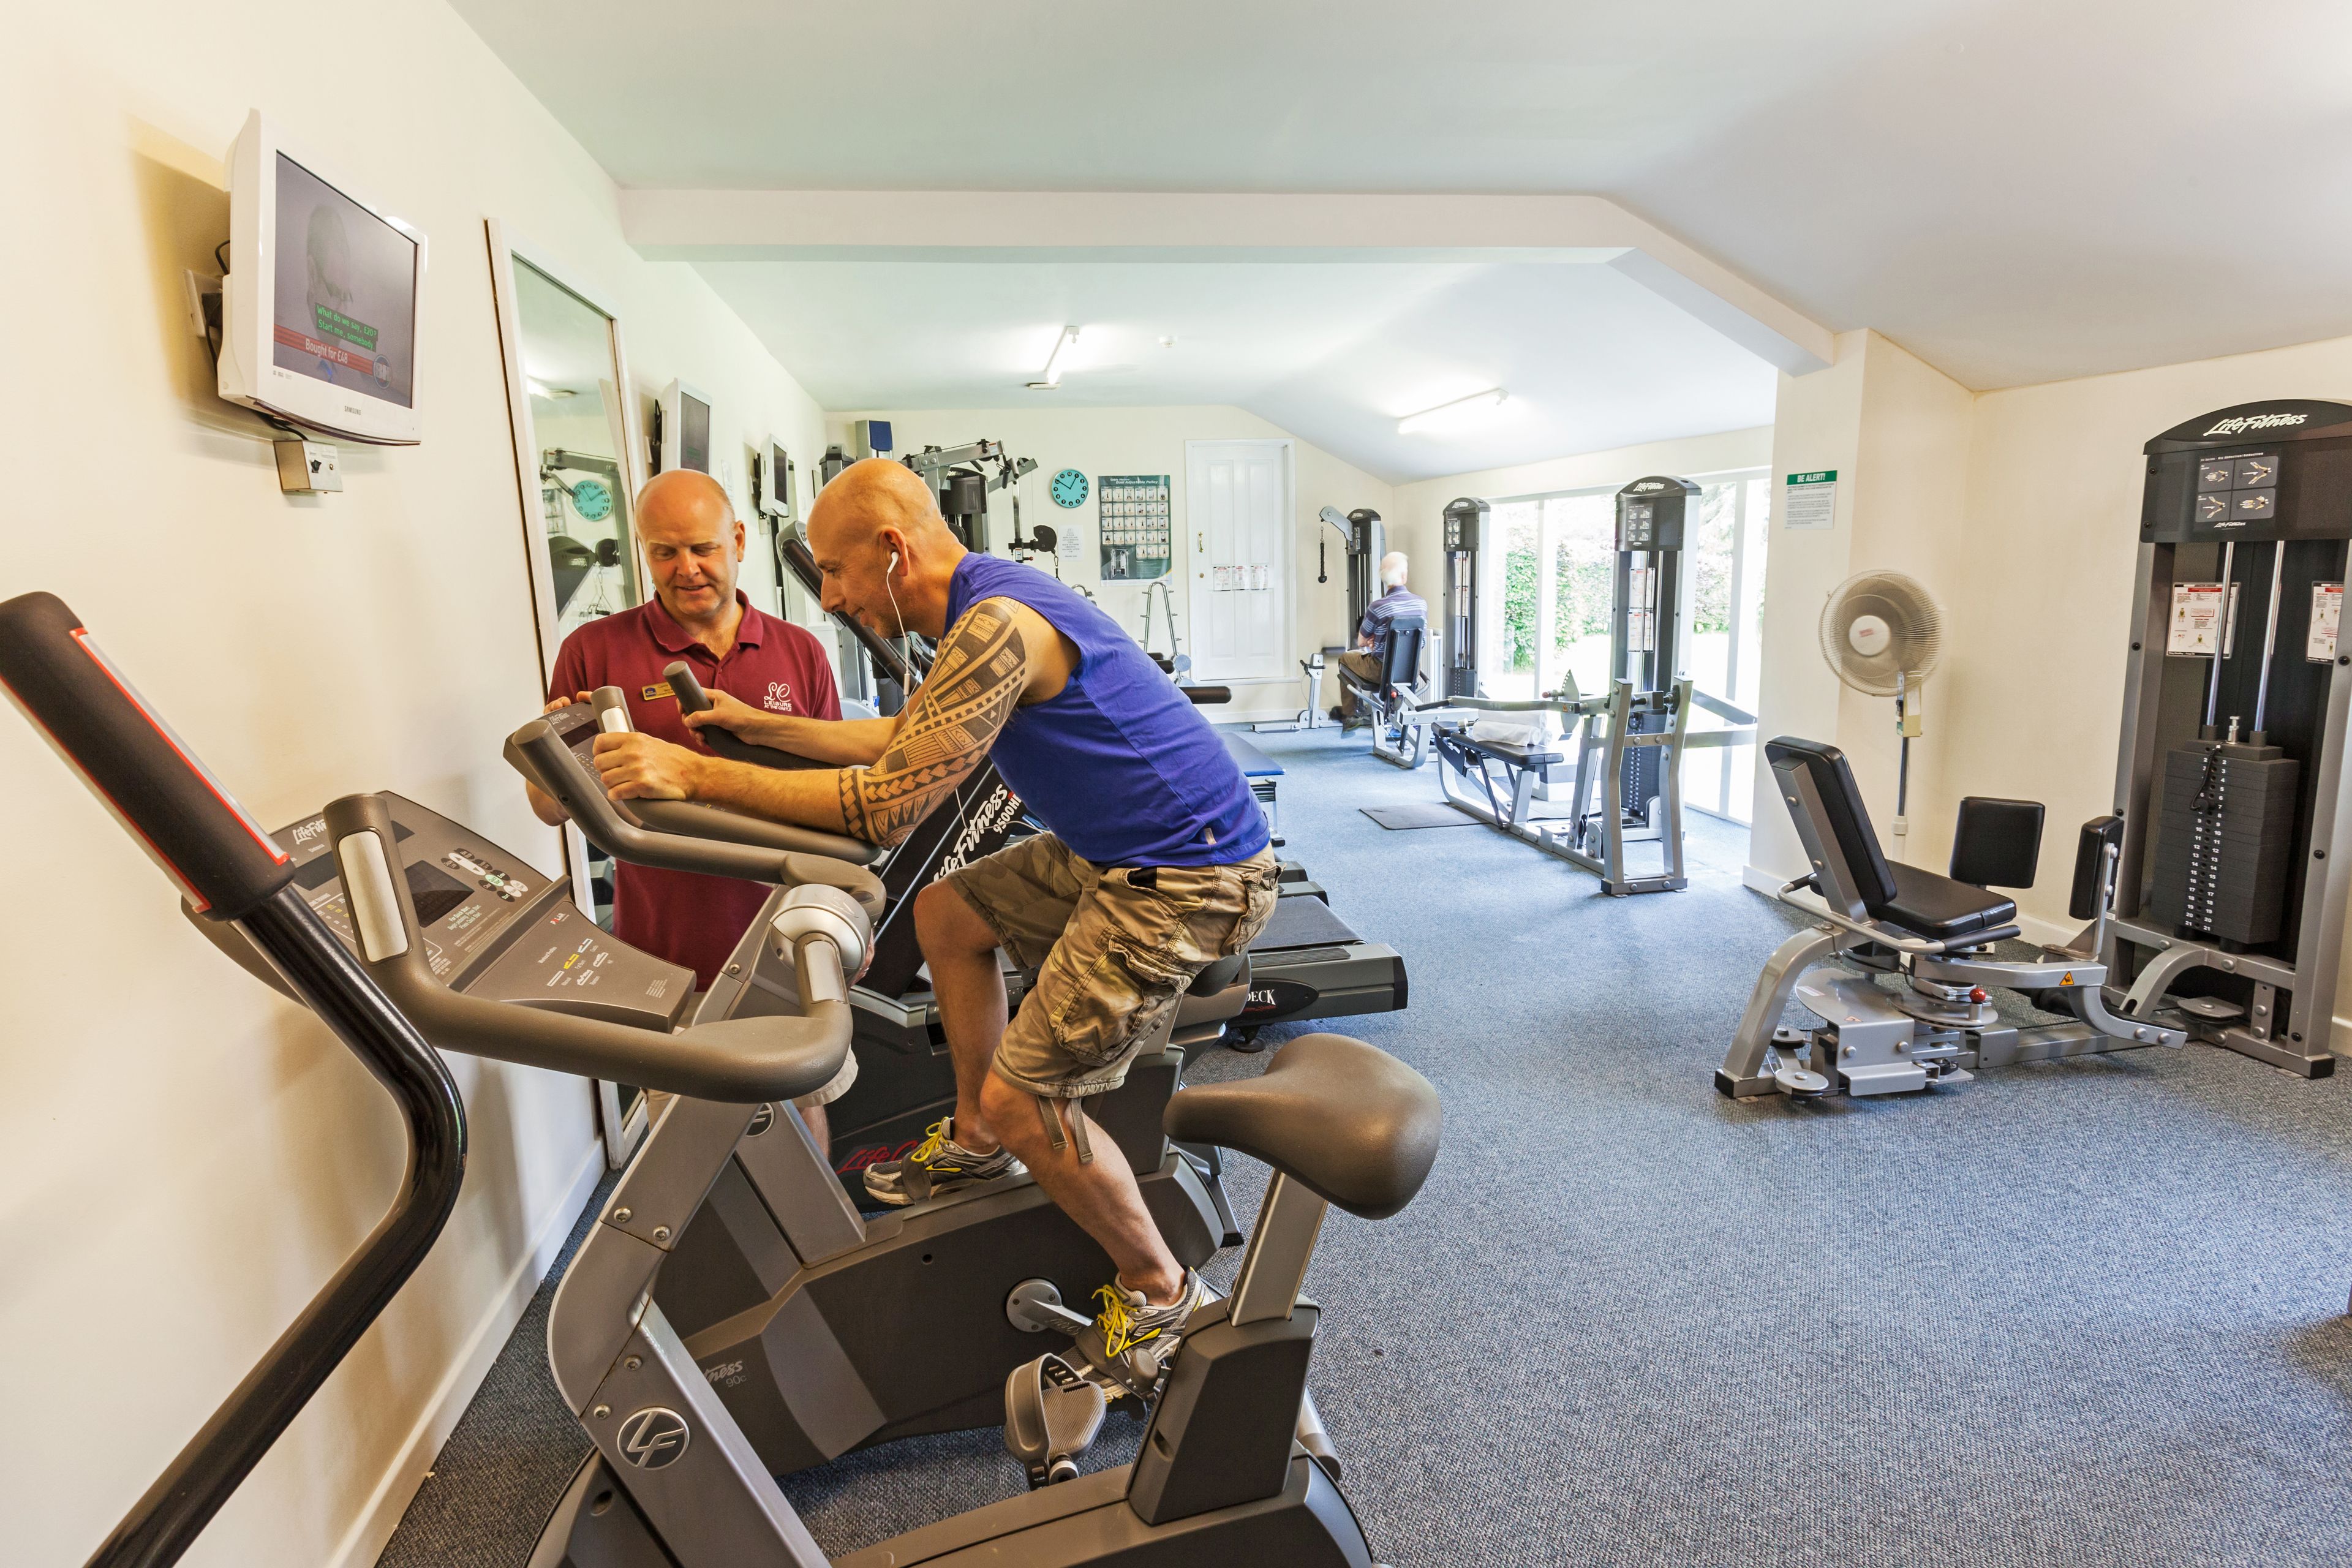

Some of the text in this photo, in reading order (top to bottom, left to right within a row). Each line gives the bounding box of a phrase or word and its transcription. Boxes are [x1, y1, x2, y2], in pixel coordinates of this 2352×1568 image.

[317, 306, 332, 319] What
[333, 313, 341, 323] do
[318, 319, 333, 333] Start
[306, 338, 348, 364] Bought for £48
[344, 405, 361, 415] SAMSUNG
[1806, 473, 1826, 482] ALERT!
[726, 1375, 747, 1387] 90c
